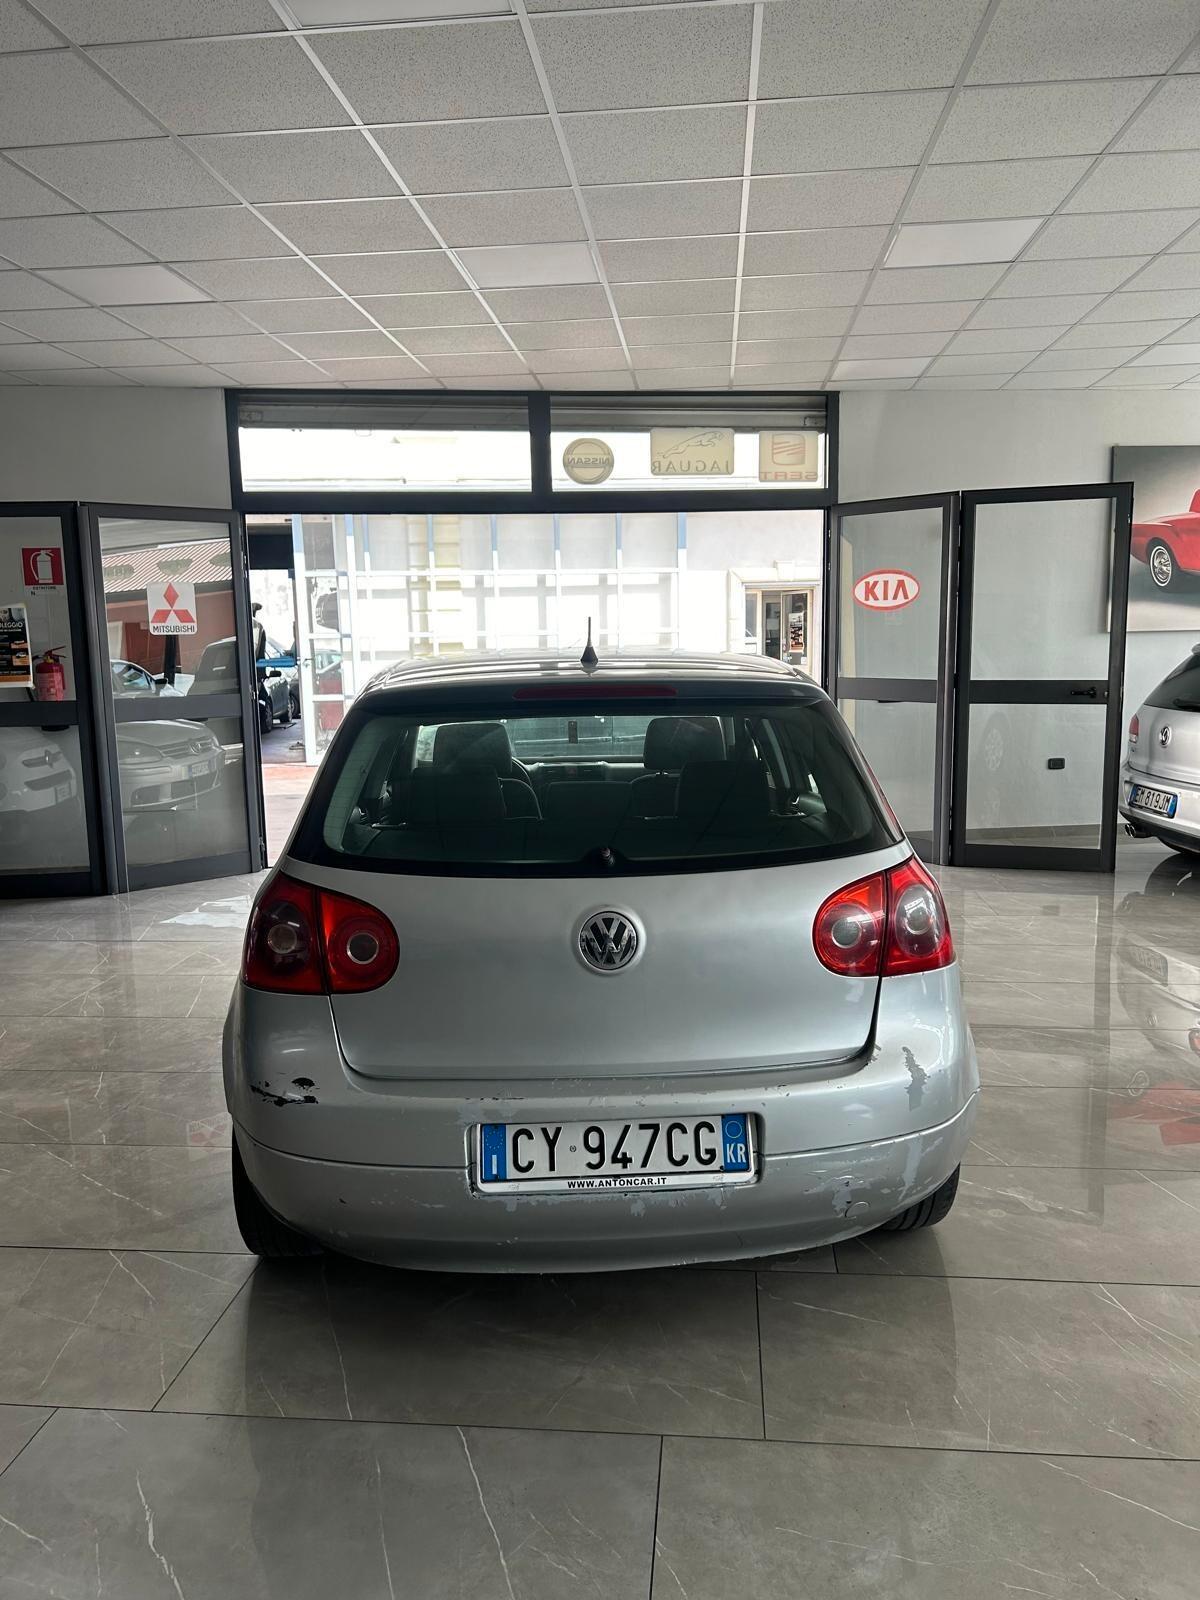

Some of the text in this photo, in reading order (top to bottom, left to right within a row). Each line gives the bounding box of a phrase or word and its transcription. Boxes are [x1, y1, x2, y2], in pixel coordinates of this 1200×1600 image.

[864, 579, 909, 601] KIA
[152, 625, 195, 633] MITSUBISHI
[511, 1126, 563, 1174] CY
[582, 1120, 718, 1170] 947CG
[726, 1142, 747, 1165] KR
[566, 1176, 668, 1190] WWW.ANTONCAR.IT
